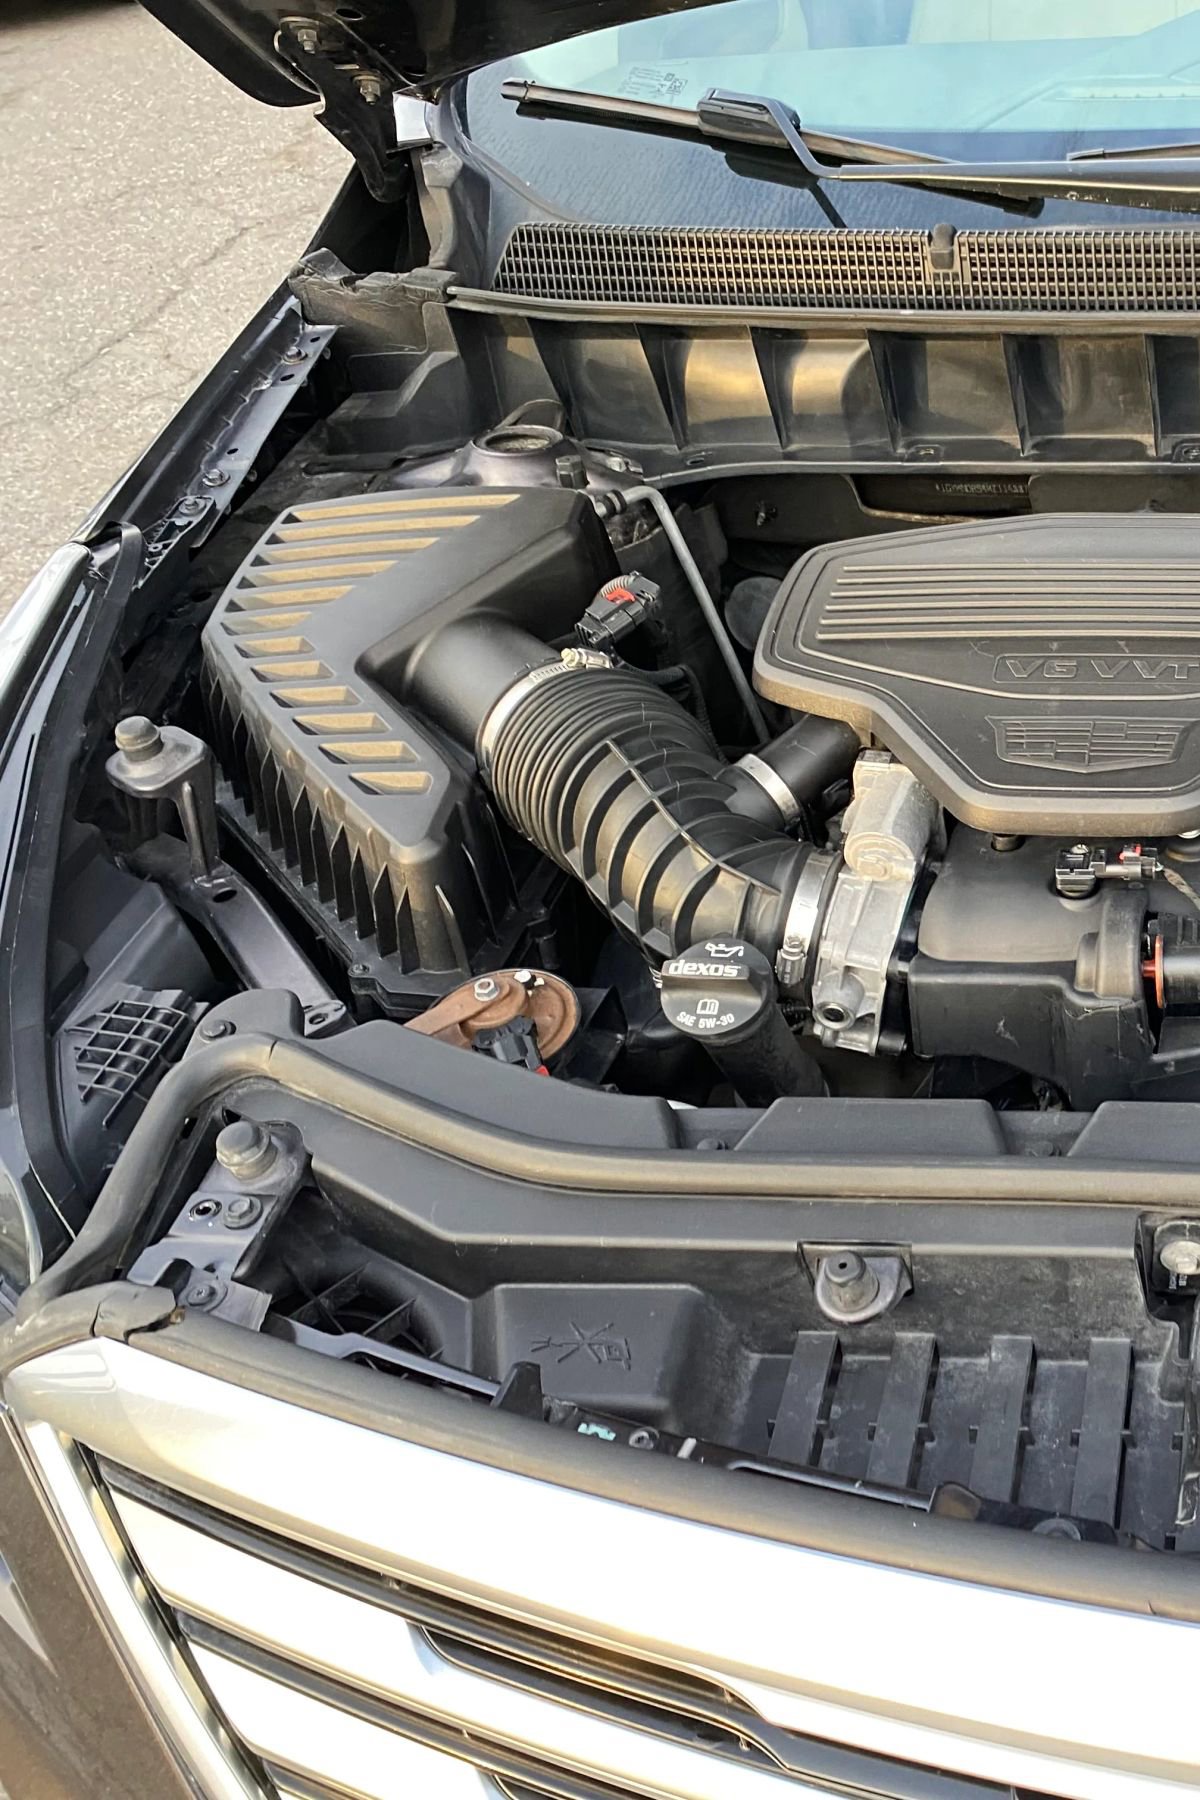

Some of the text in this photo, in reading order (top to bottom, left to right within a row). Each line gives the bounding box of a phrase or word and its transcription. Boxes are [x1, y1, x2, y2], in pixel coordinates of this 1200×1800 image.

[1006, 659, 1200, 680] V6 VVT
[669, 960, 740, 977] dexos
[677, 1013, 734, 1029] SAE 5W-30
